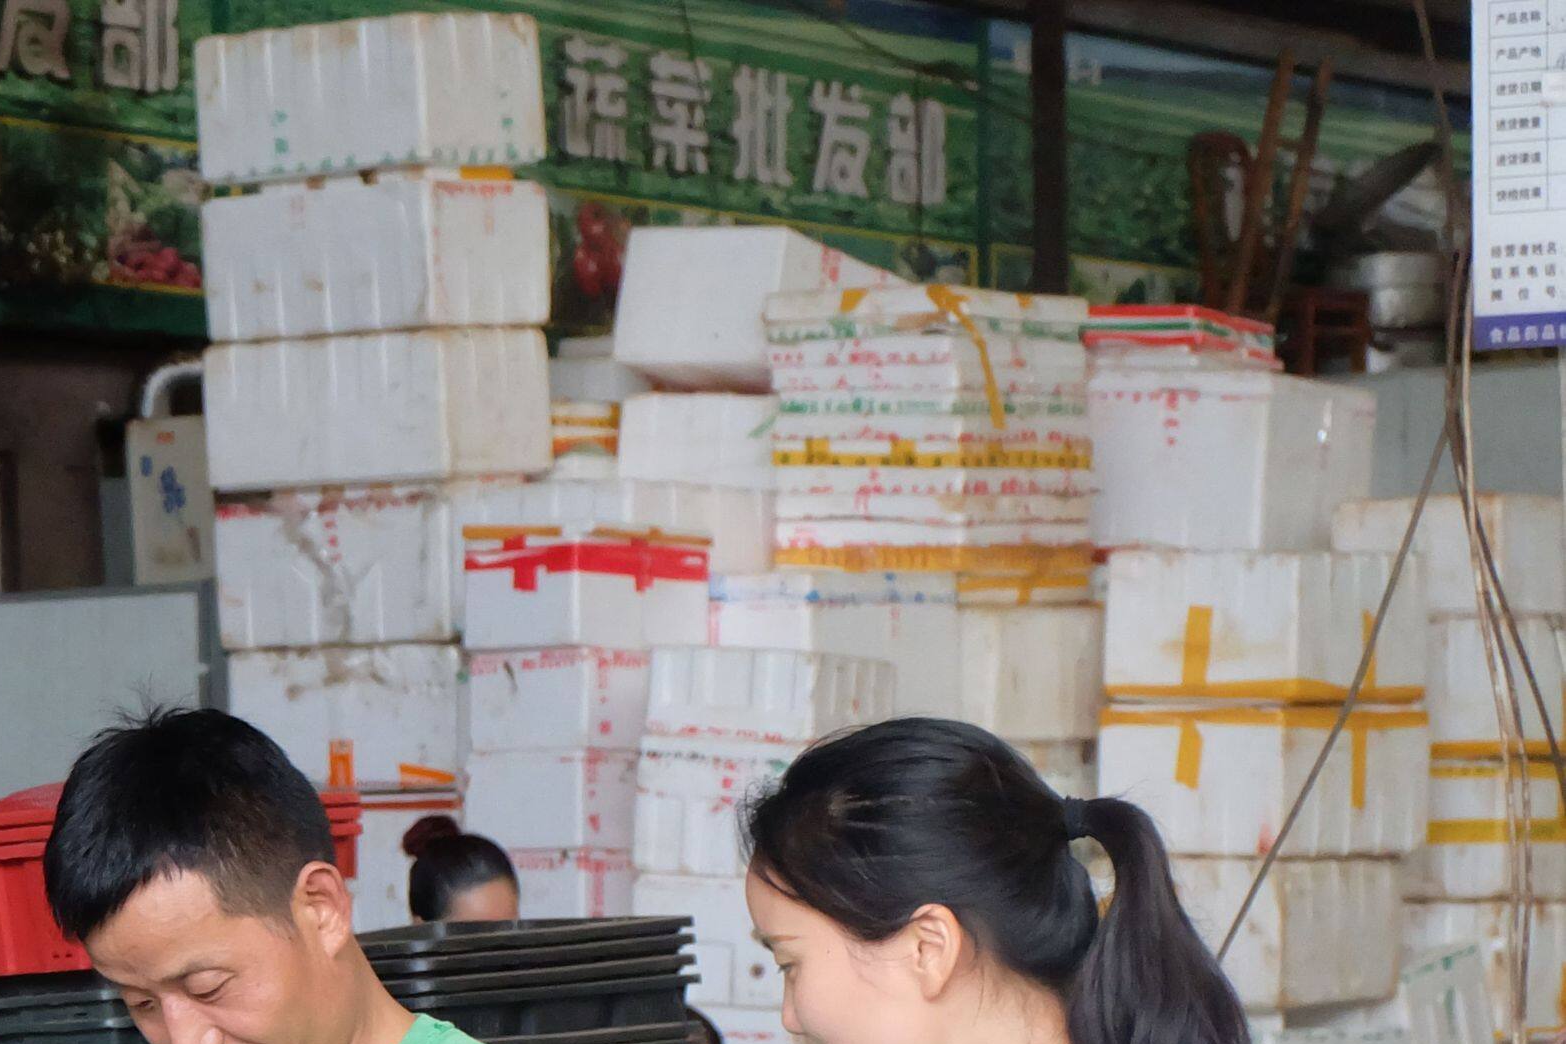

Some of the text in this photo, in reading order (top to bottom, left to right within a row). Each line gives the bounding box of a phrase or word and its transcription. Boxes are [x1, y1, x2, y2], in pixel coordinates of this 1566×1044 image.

[565, 36, 946, 206] 蔬菜批发部
